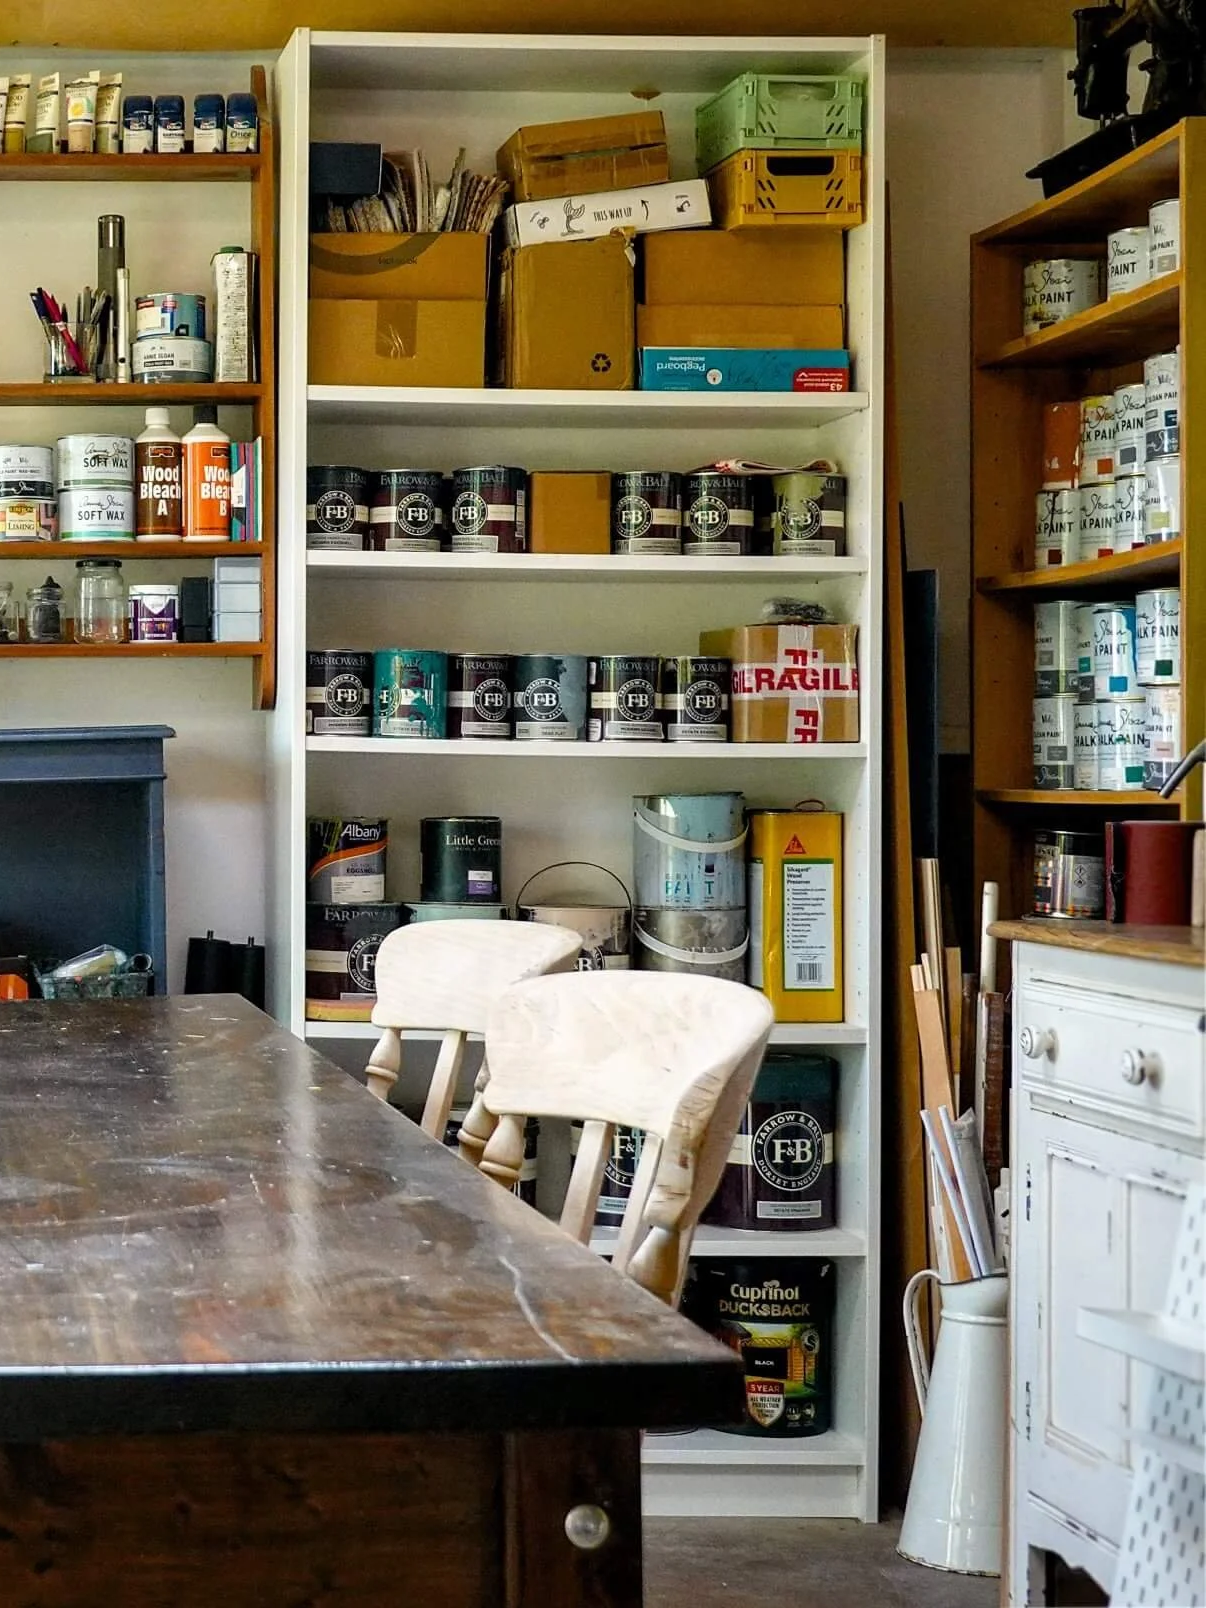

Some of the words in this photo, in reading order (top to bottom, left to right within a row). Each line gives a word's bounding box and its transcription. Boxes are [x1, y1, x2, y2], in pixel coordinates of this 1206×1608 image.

[594, 211, 608, 222] THIS
[609, 208, 623, 219] WAY
[1111, 262, 1137, 277] PAINT
[1040, 291, 1075, 304] PAINT
[656, 361, 706, 372] Pegboard
[830, 383, 843, 391] 43
[83, 457, 108, 468] SOFT
[113, 457, 129, 468] WAX
[142, 465, 179, 482] Wood
[140, 482, 181, 499] Bleach
[201, 482, 231, 499] Blea
[157, 500, 168, 516] A
[325, 505, 348, 518] F&B
[407, 508, 429, 521] F&B
[458, 507, 477, 520] F&B
[78, 510, 102, 521] SOFT
[106, 510, 125, 521] WAX
[621, 510, 643, 524] F&B
[696, 511, 720, 524] F&B
[8, 522, 34, 530] LIMING
[1044, 522, 1074, 535] PAINT
[1151, 625, 1178, 638] PAIN
[336, 689, 358, 702] F&B
[484, 693, 503, 707] F&B
[533, 693, 557, 707] F&B
[627, 693, 649, 707] F&B
[695, 695, 716, 708] F&B
[1074, 735, 1096, 747] CHALK
[341, 824, 382, 840] Albany
[446, 834, 475, 846] Little
[665, 880, 715, 895] PAIT
[757, 1114, 795, 1145] FARROW
[807, 1118, 822, 1145] BALL
[772, 1138, 813, 1164] F&B
[757, 1160, 788, 1187] DORSET
[791, 1159, 821, 1188] ENGLAND
[730, 1283, 800, 1302] Cuprinol
[719, 1300, 811, 1317] DUCKSBACK
[756, 1384, 780, 1392] YEAR
